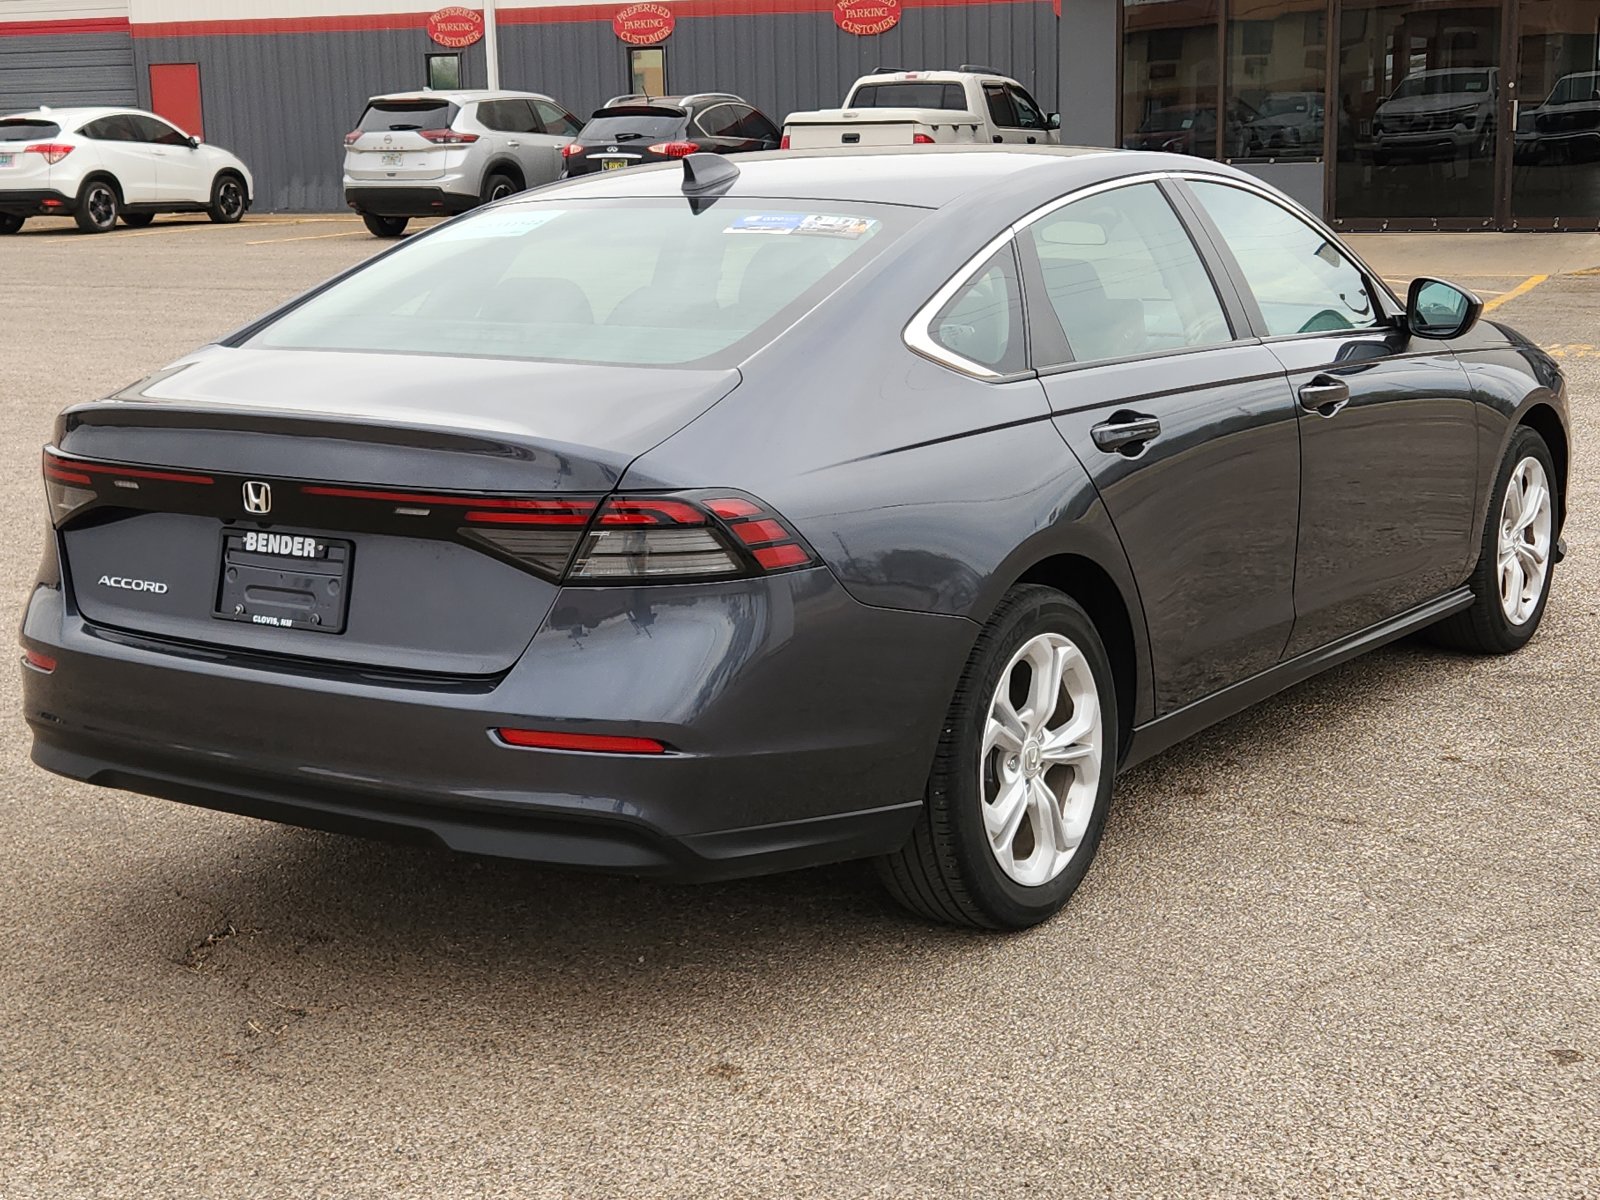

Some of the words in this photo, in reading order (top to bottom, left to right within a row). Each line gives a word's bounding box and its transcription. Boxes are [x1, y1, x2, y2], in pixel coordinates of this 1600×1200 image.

[430, 7, 481, 25] PREFERRED
[616, 3, 671, 23] PREFERRED
[845, 7, 888, 18] PARKING
[437, 22, 474, 31] PARKING
[624, 19, 663, 30] PARKING
[841, 15, 896, 34] CUSTOMER
[433, 30, 480, 47] CUSTOMER
[620, 26, 670, 44] CUSTOMER
[245, 532, 315, 558] BENDER
[97, 575, 168, 594] ACCORD
[252, 614, 279, 626] CLOVIS,
